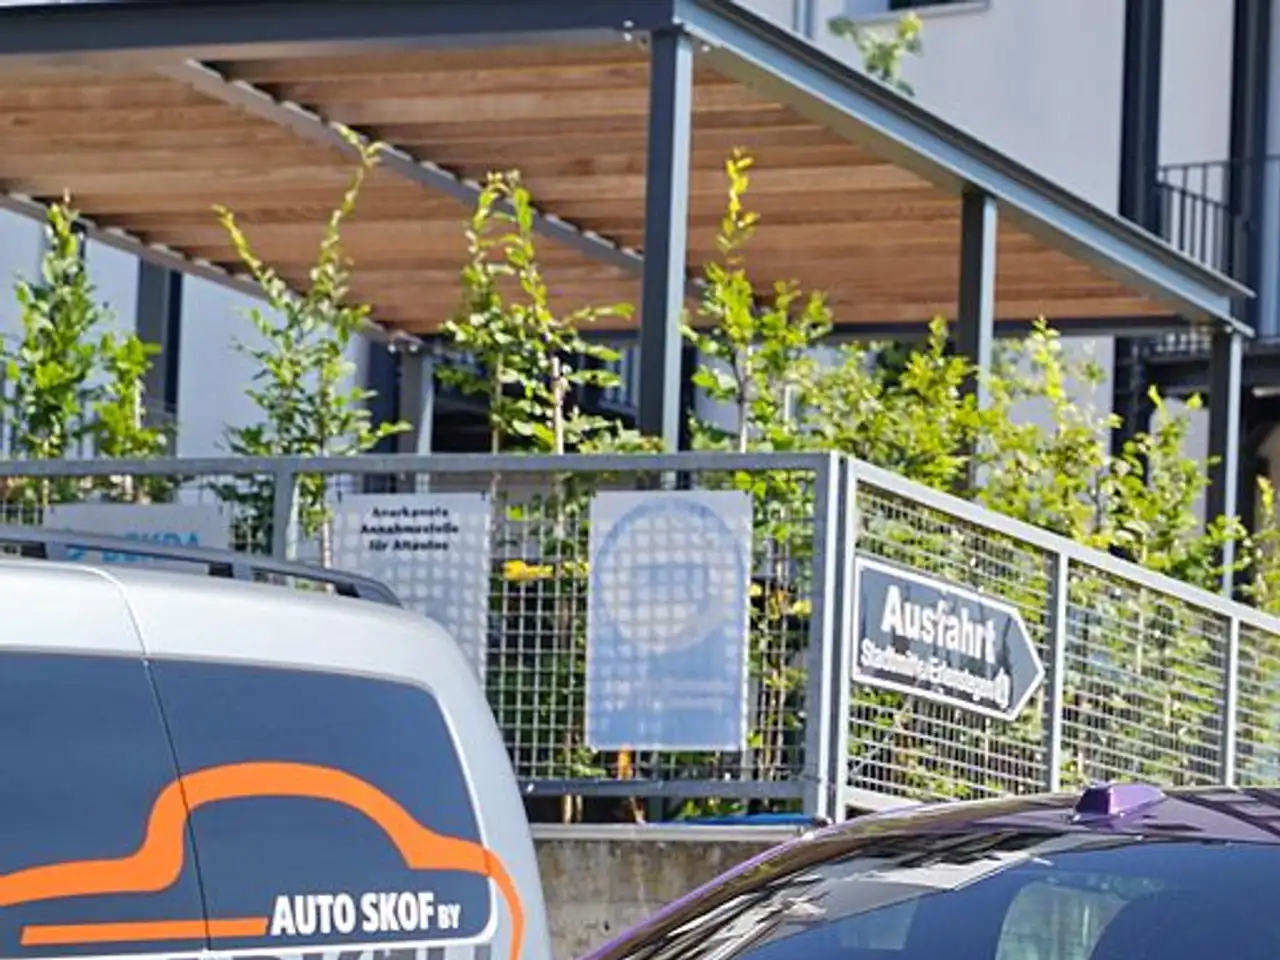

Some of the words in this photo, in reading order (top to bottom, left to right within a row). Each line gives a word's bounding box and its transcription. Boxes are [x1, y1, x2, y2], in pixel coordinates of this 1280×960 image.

[881, 584, 996, 664] Ausfahrt
[271, 895, 354, 936] AUTO
[363, 892, 434, 932] SKOF
[438, 904, 461, 929] BY
